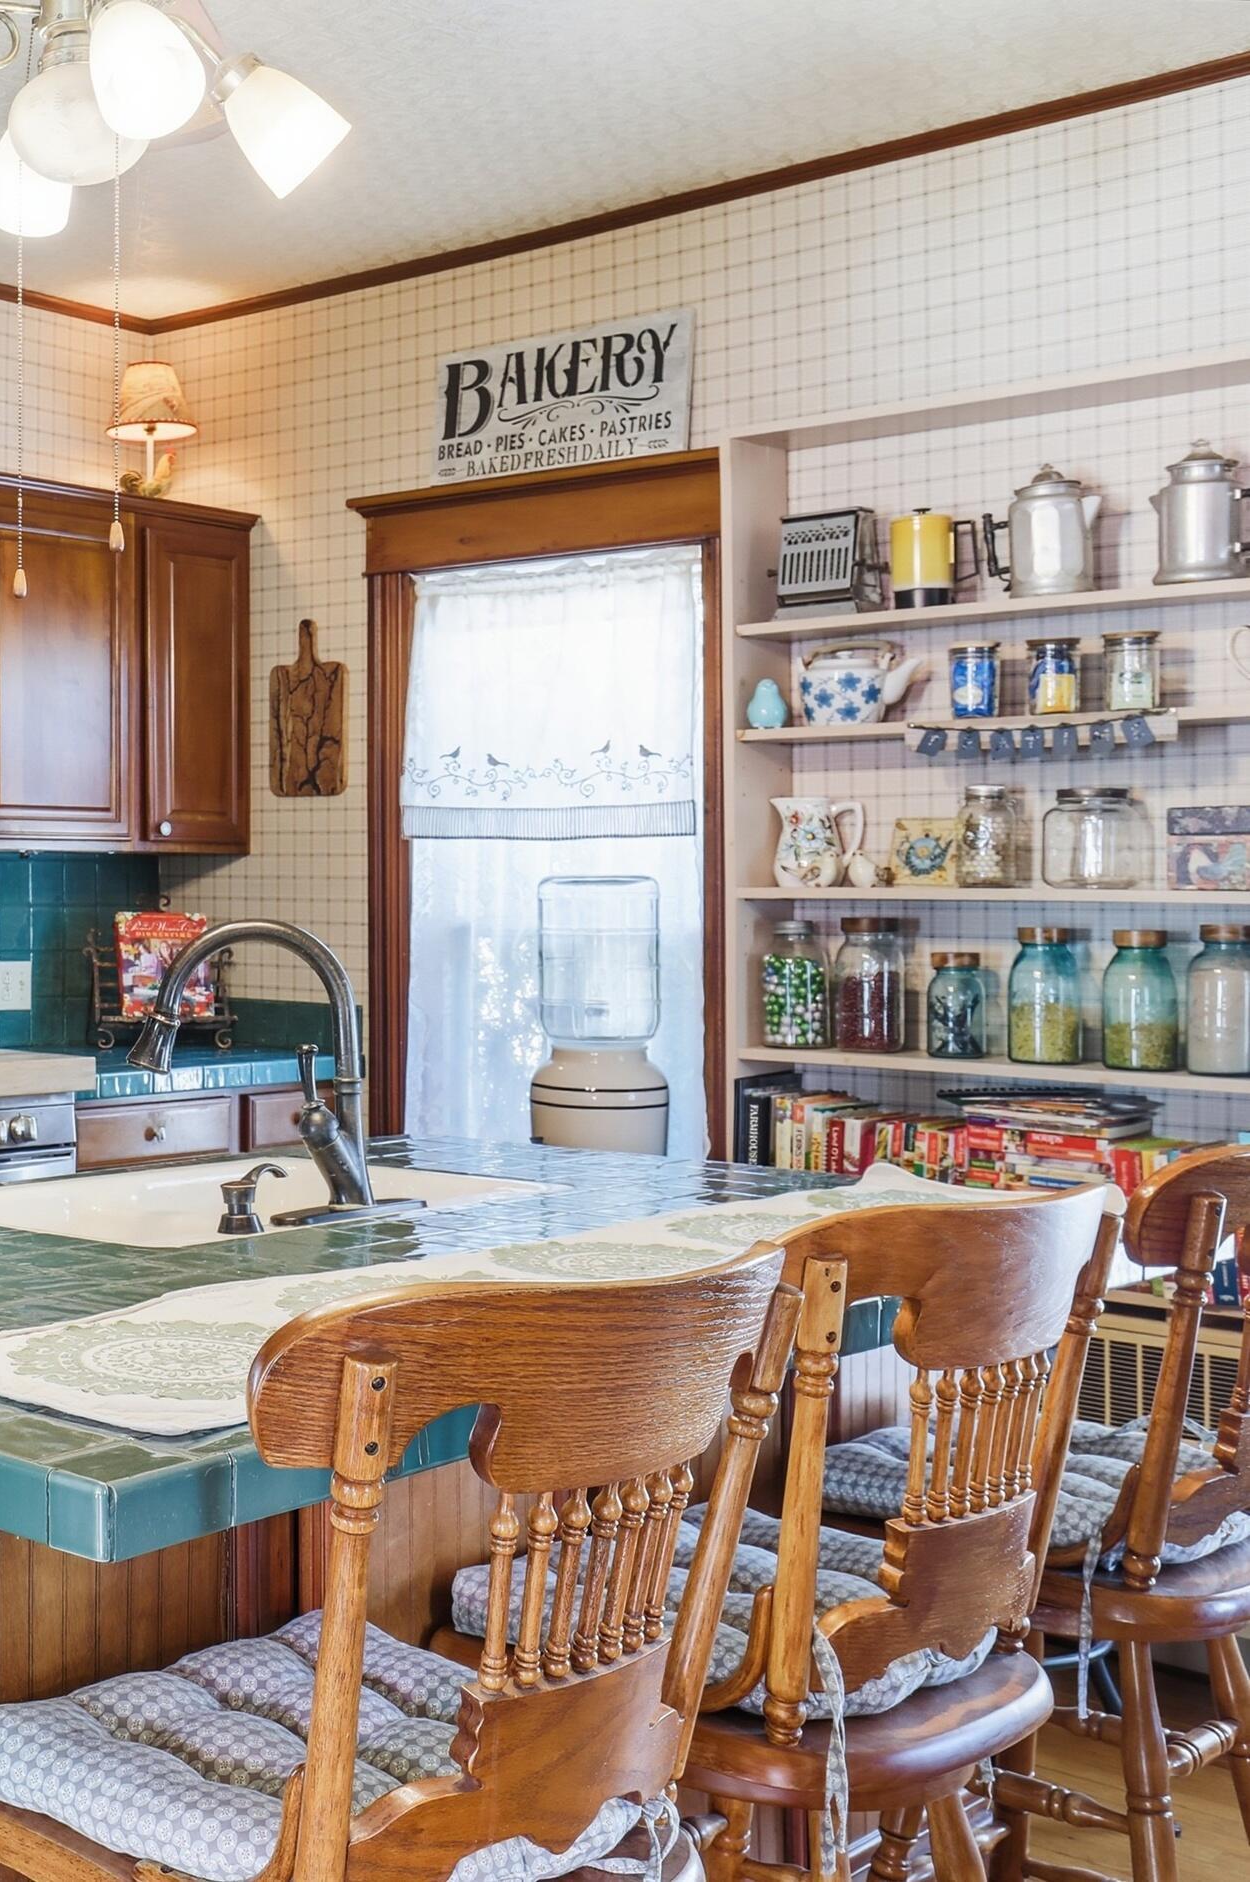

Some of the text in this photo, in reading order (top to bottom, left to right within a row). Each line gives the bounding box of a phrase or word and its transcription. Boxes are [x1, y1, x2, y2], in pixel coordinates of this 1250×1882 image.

[442, 323, 678, 441] BAKERY
[437, 410, 672, 461] BREAD PIES CAKES PASTRIES
[466, 437, 638, 478] BAKED FRESH DAILY
